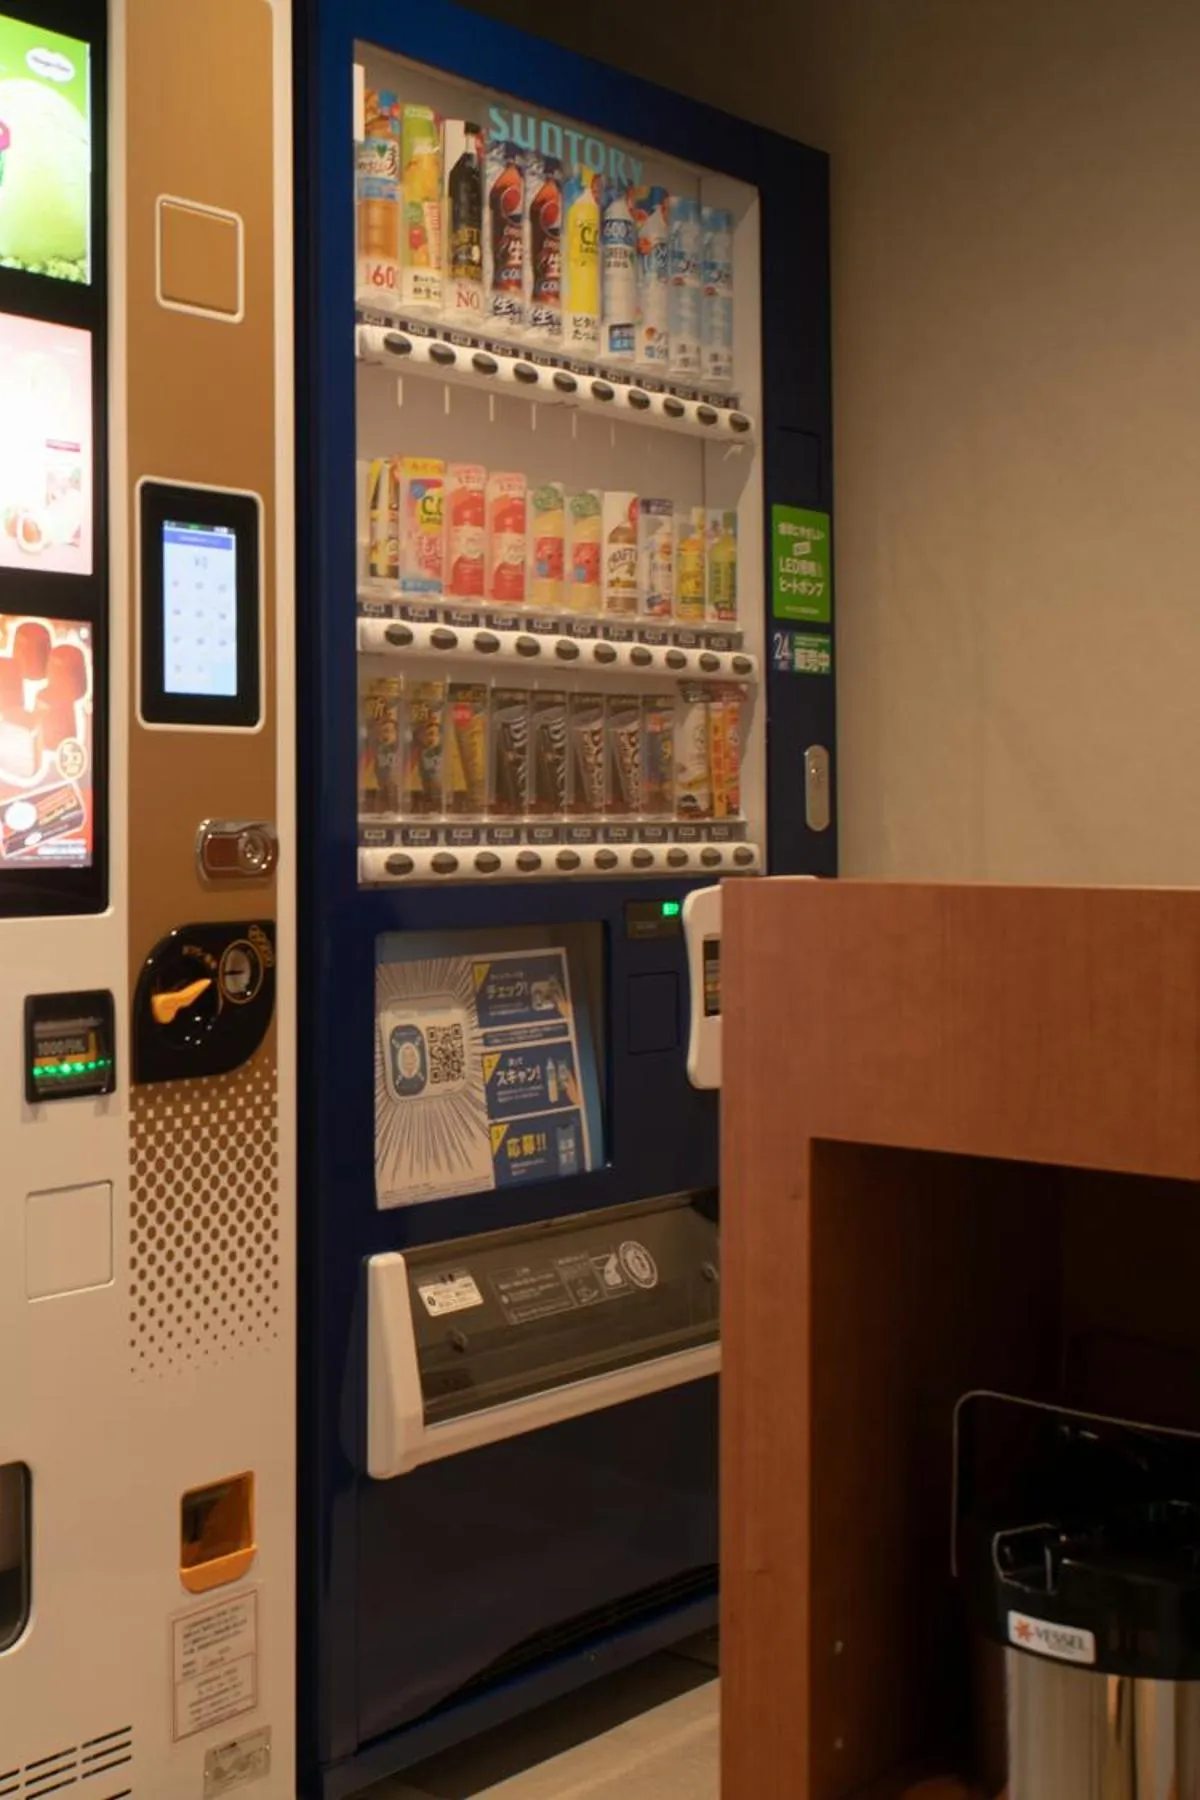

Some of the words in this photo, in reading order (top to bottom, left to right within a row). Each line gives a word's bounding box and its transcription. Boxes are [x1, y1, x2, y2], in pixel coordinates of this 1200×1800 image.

[489, 107, 644, 187] SUNTORY
[496, 1064, 541, 1087] スキャン!
[1035, 1626, 1085, 1651] VESSEL
